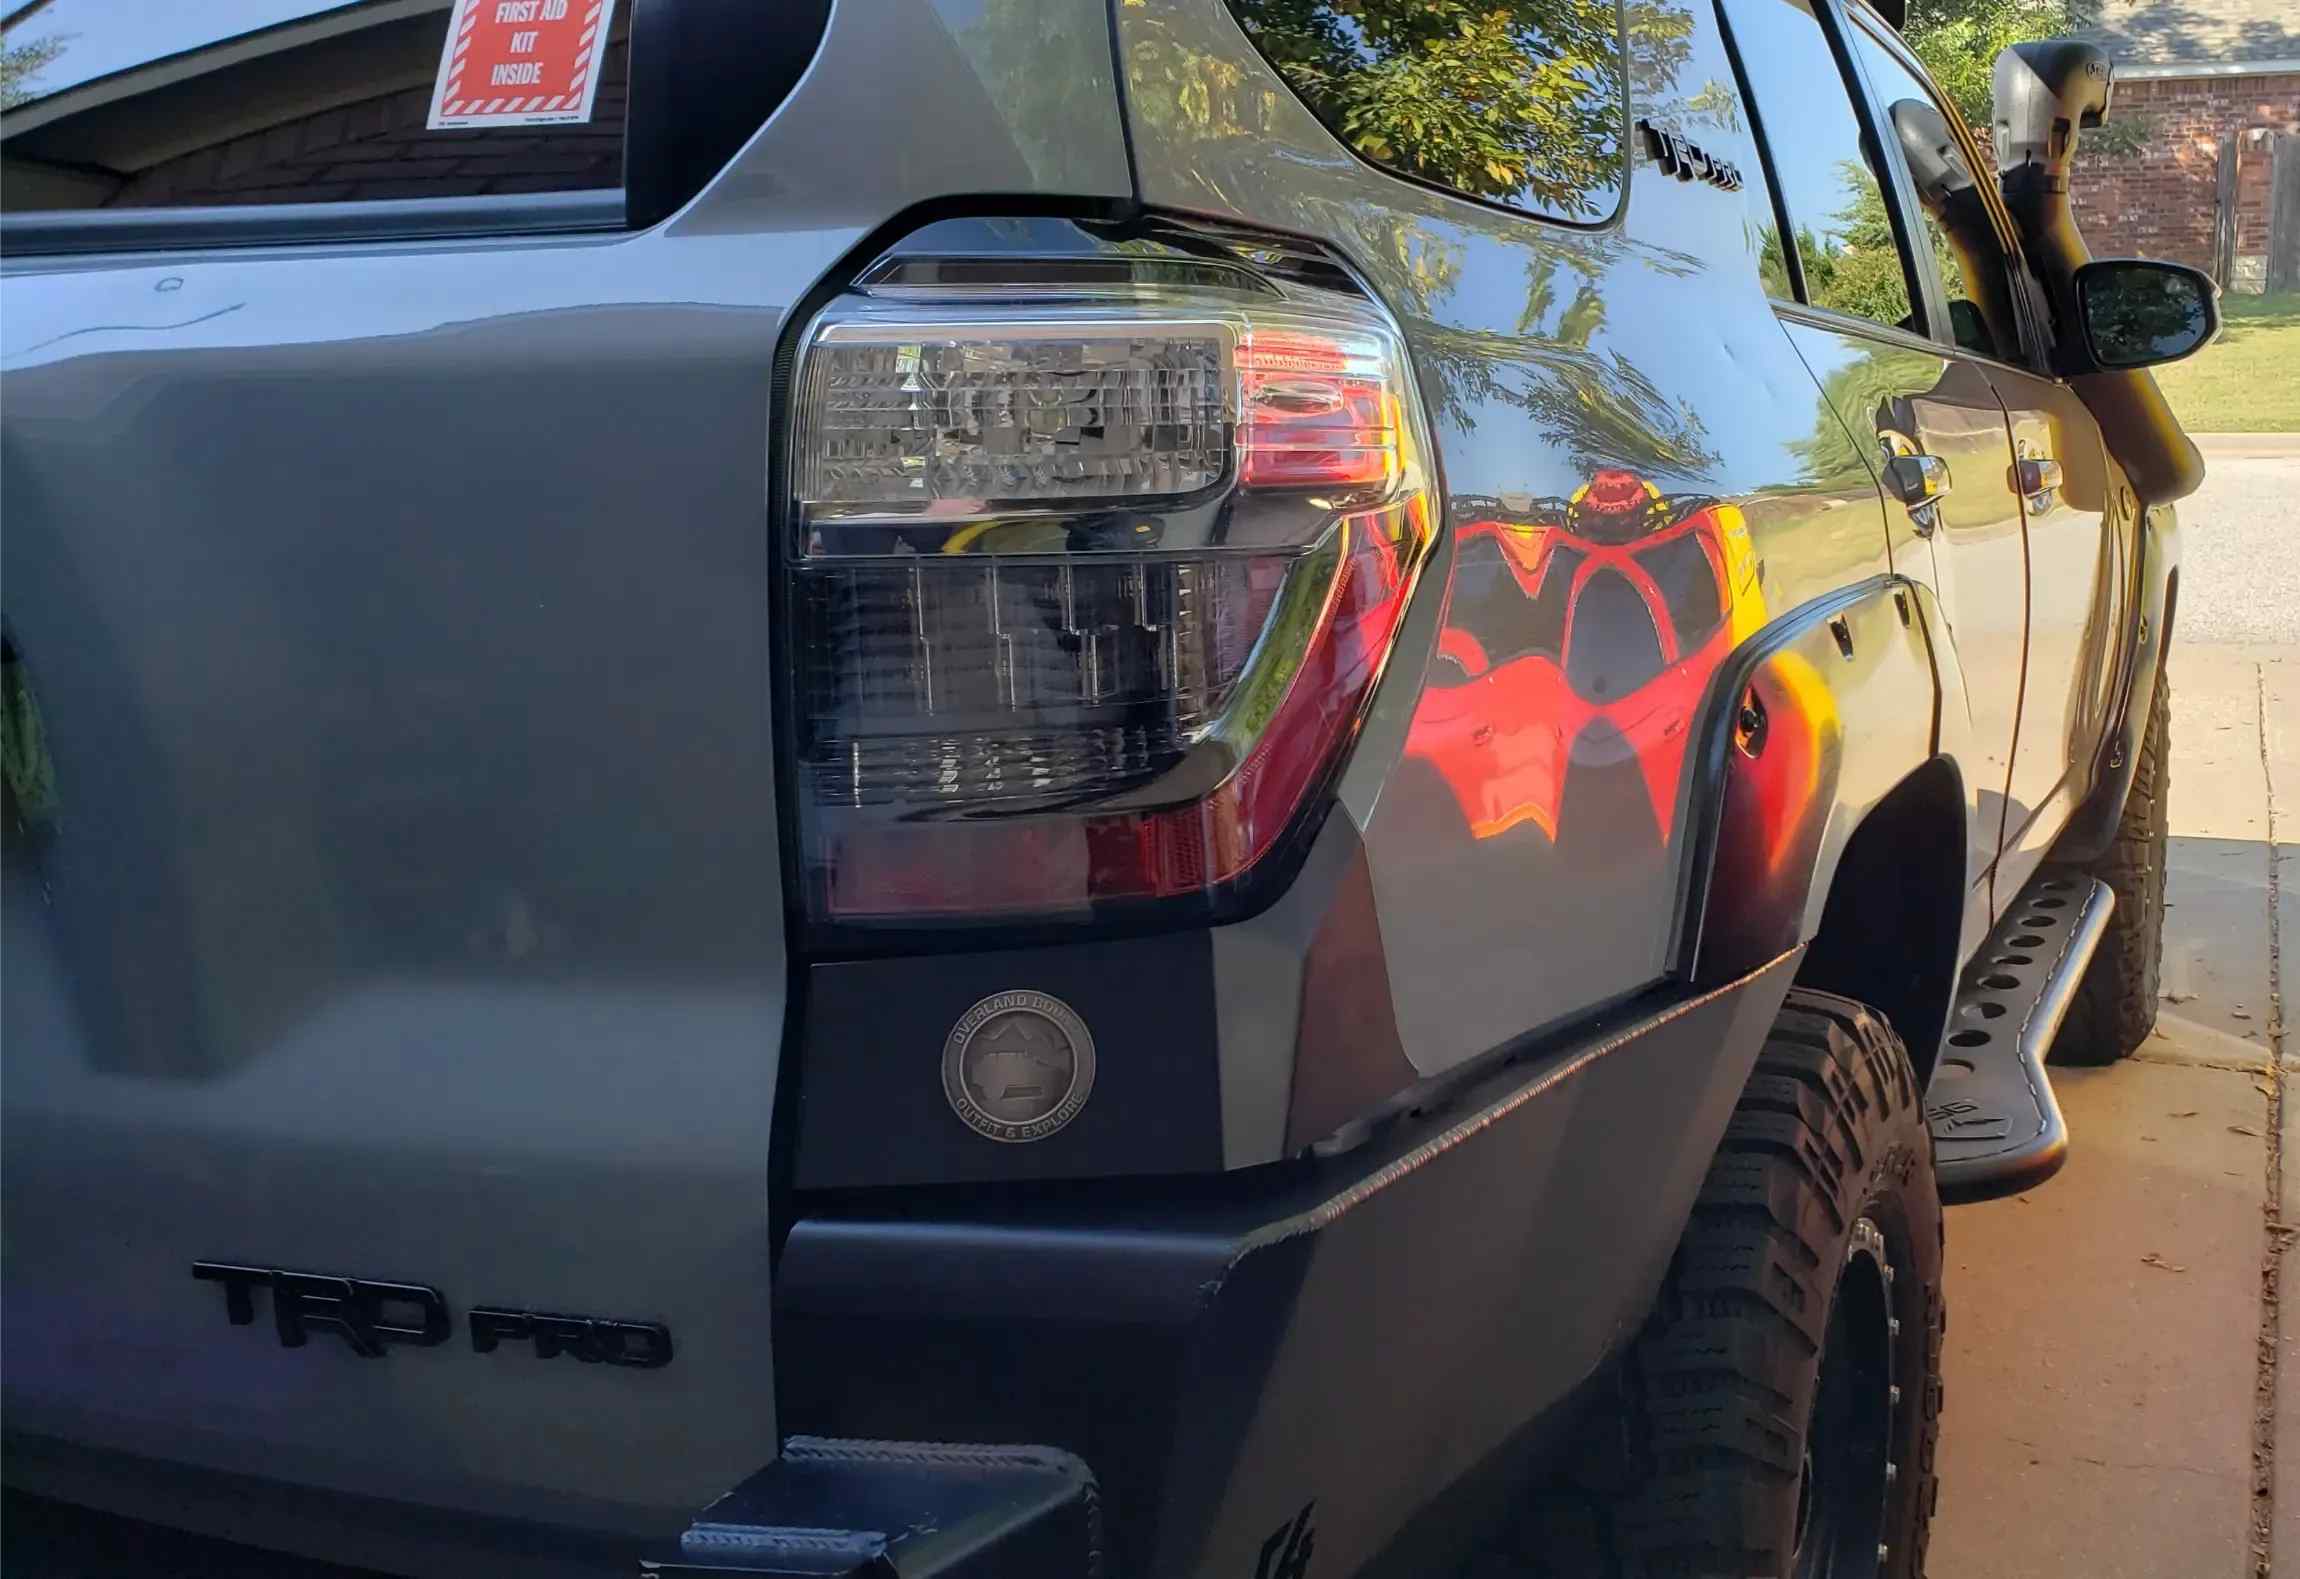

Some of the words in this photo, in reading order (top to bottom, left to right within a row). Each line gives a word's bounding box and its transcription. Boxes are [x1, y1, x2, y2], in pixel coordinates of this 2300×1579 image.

[495, 1, 541, 23] FIRST
[540, 0, 568, 20] AID
[510, 31, 539, 53] KIT
[491, 62, 544, 86] INSIDE
[953, 995, 1027, 1045] OVERLAND
[956, 1098, 1002, 1138] OUTFIT
[1004, 1126, 1018, 1138] &
[1022, 1089, 1085, 1138] EXPLORE
[192, 1259, 452, 1358] TRD
[468, 1305, 674, 1368] PRO
